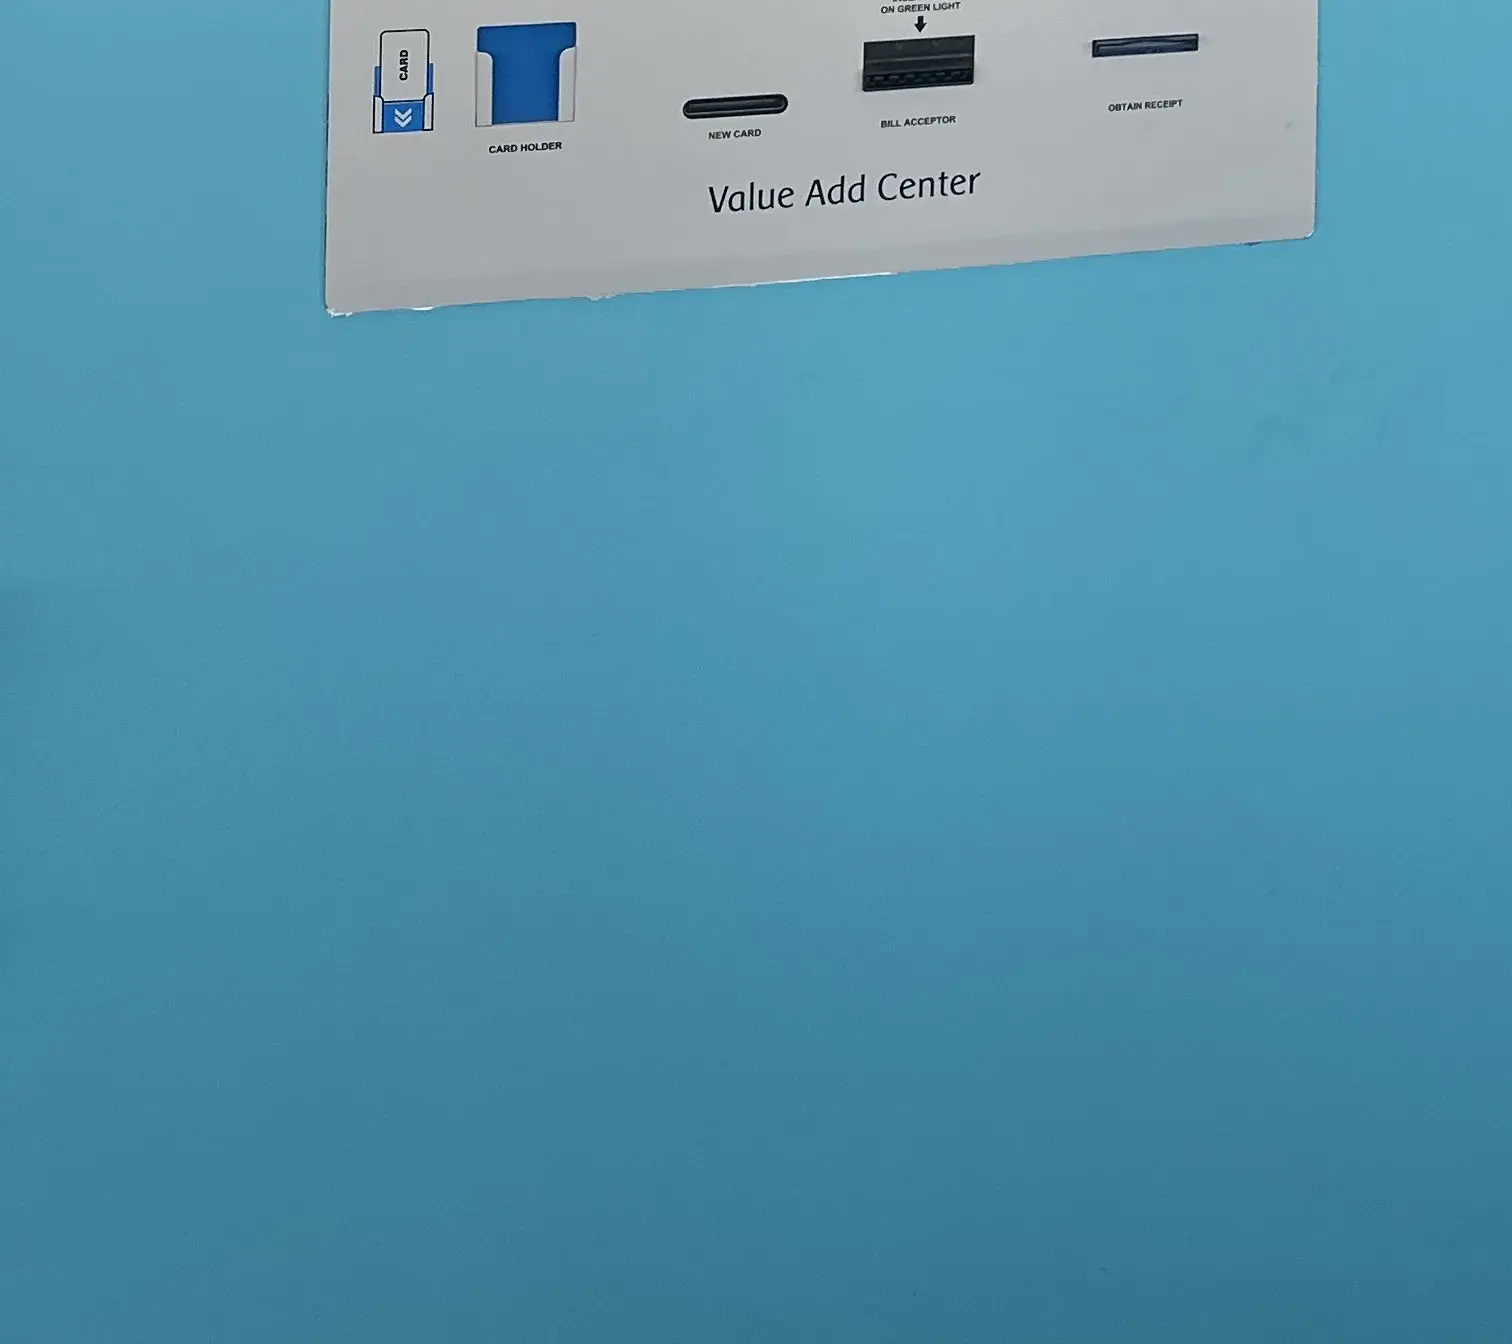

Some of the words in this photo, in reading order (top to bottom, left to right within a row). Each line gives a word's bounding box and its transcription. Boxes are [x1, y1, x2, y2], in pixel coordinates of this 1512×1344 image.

[399, 49, 409, 81] CARD
[1107, 101, 1143, 113] OBTAIN
[1144, 98, 1183, 110] RECEIPT
[880, 119, 902, 129] BILL
[903, 115, 957, 127] ACCEPTOR
[708, 130, 732, 140] NEW
[733, 128, 762, 139] CARD
[488, 144, 519, 154] CARD
[520, 141, 563, 152] HOLDER
[708, 181, 795, 214] Value
[804, 173, 866, 207] Add
[877, 171, 982, 201] Center
